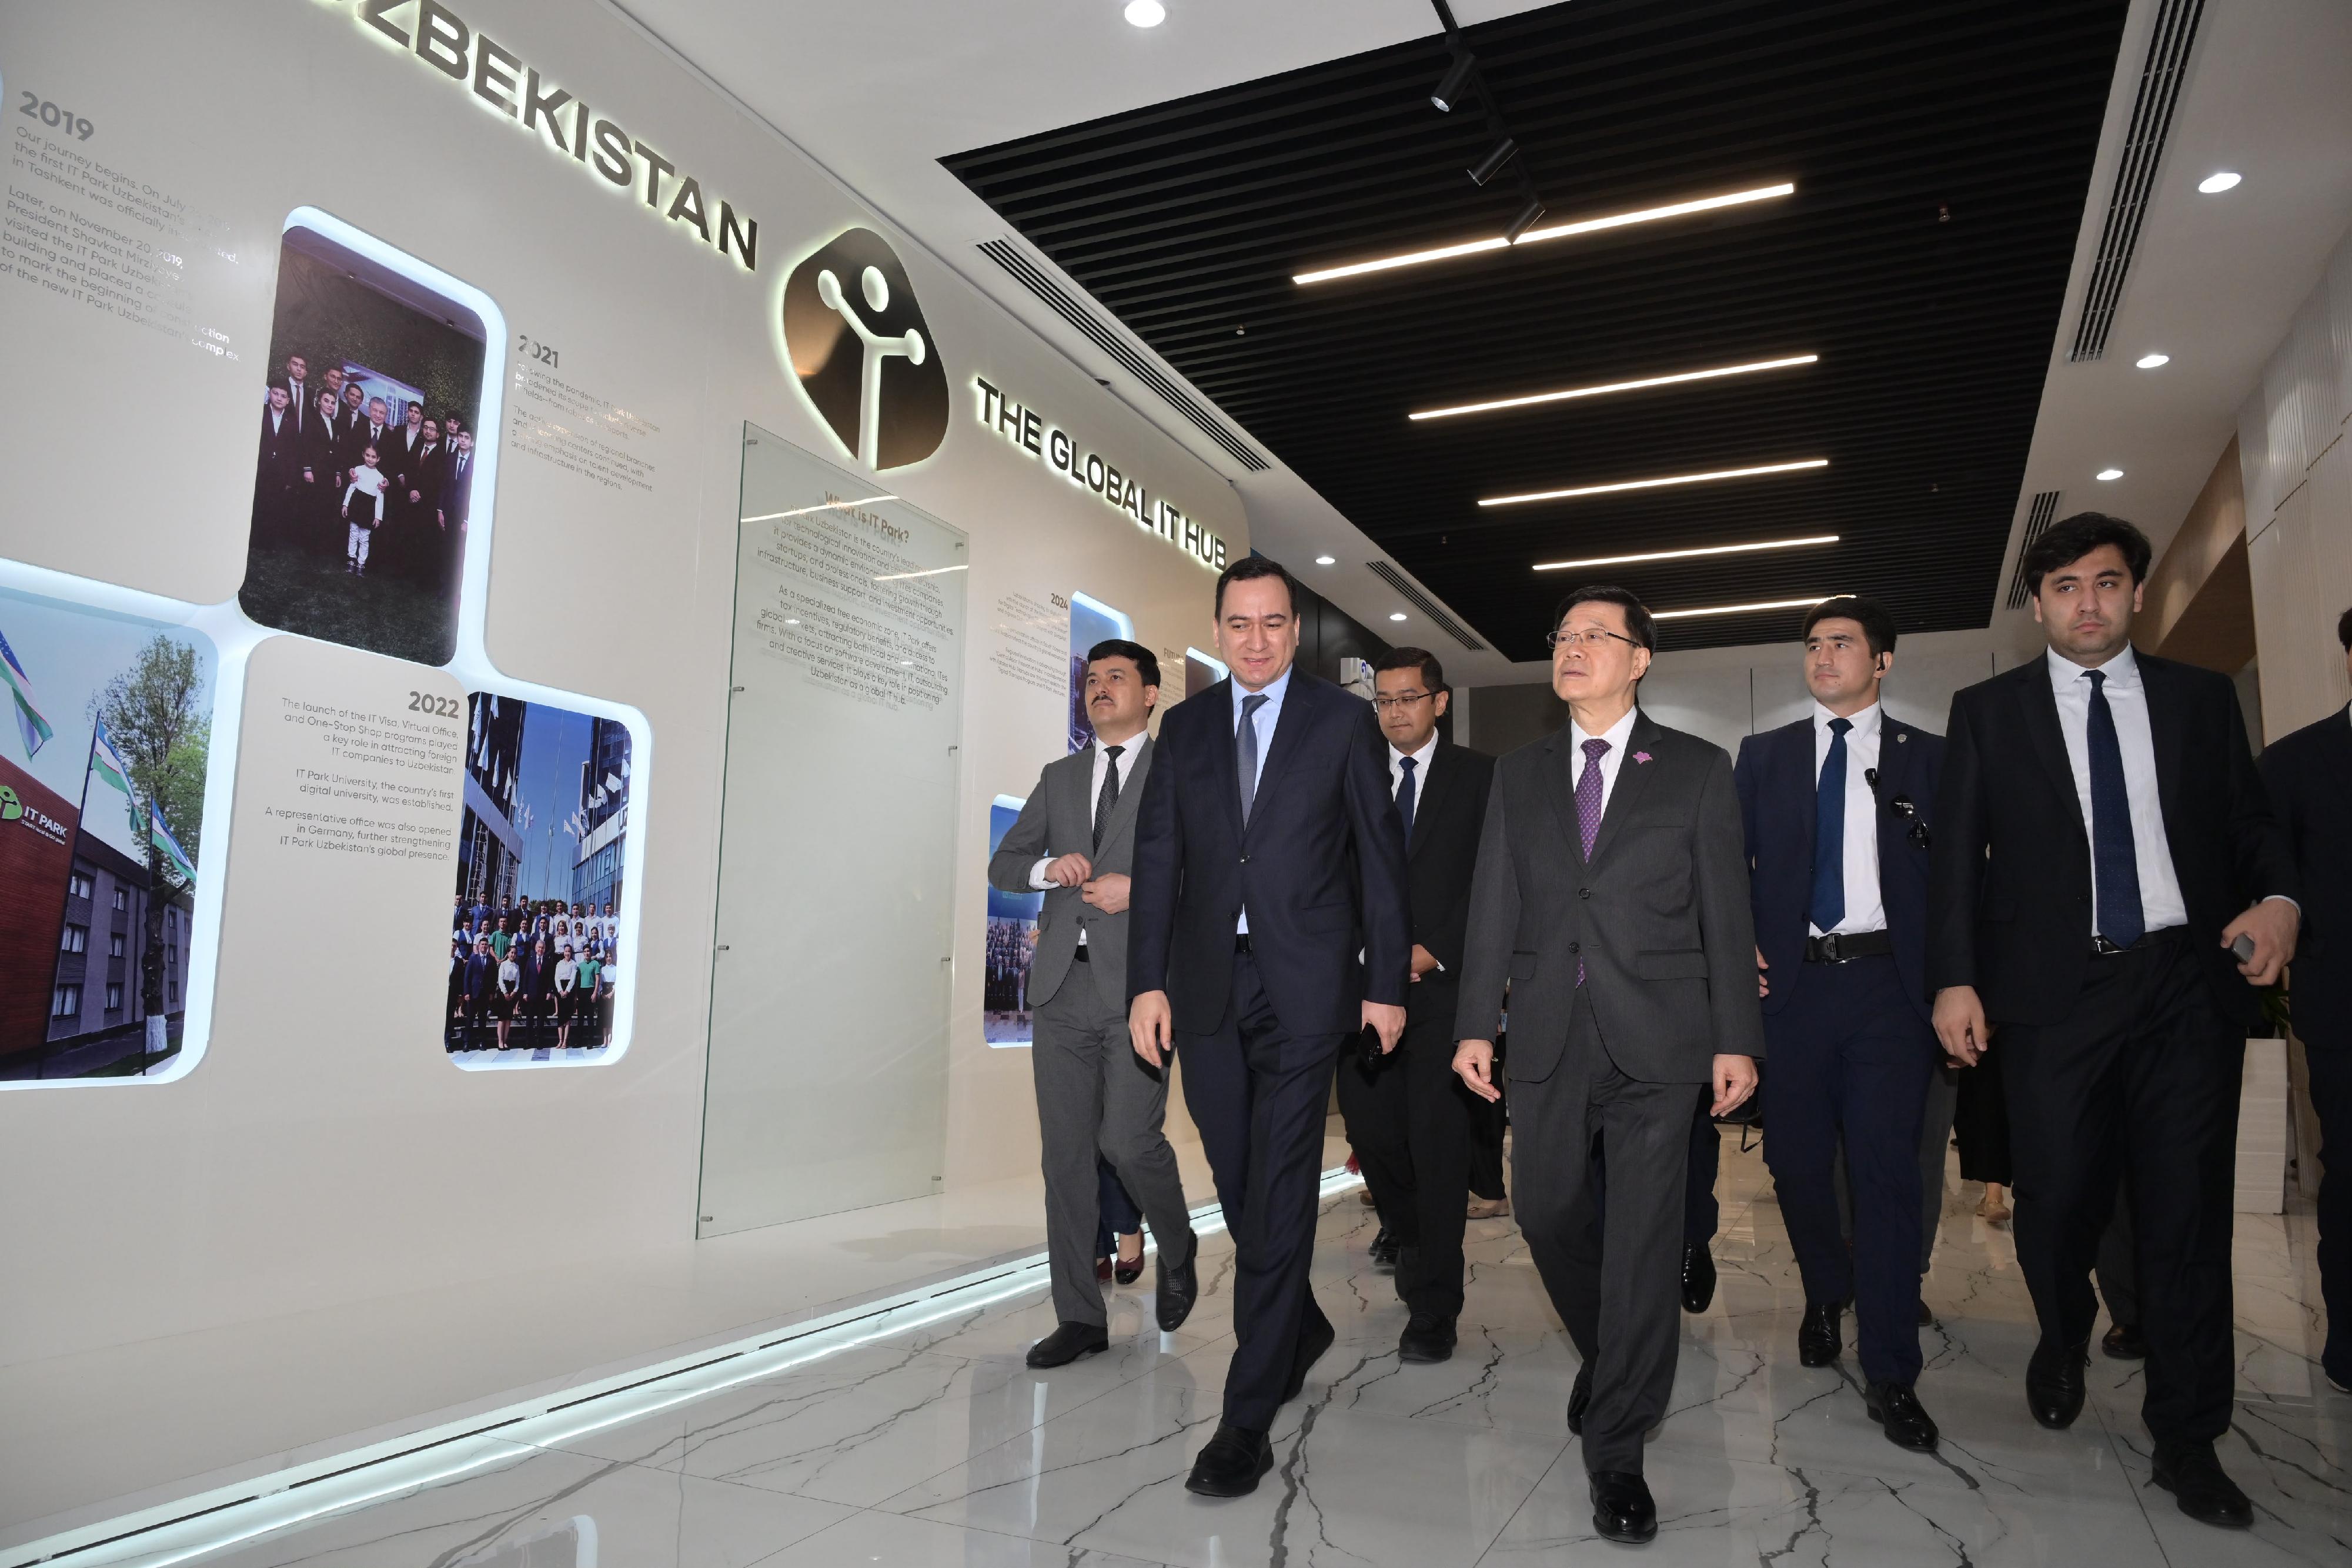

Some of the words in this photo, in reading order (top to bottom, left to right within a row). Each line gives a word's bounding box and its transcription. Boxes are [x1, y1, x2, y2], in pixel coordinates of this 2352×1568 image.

[19, 91, 94, 141] 2019
[356, 0, 758, 272] ZBEKISTAN
[14, 141, 37, 158] the
[40, 152, 64, 171] first
[67, 164, 79, 176] IT
[81, 170, 109, 191] Park
[112, 184, 185, 226] Uzbekistan's
[16, 126, 42, 145] Our
[42, 138, 92, 169] journey
[95, 162, 138, 190] begins.
[142, 184, 159, 200] On
[162, 195, 186, 212] July
[28, 161, 86, 196] Tashkent
[116, 204, 165, 232] officially
[7, 199, 69, 235] President
[72, 227, 123, 258] Shavkat
[9, 184, 45, 210] Later,
[69, 210, 133, 246] November
[136, 240, 153, 257] 20,
[2, 229, 56, 262] building
[59, 256, 86, 272] and
[88, 266, 132, 290] placed
[5, 217, 49, 241] visited
[51, 235, 74, 251] the
[76, 244, 89, 256] IT
[91, 250, 118, 270] Park
[16, 268, 39, 284] the
[42, 279, 69, 296] new
[72, 288, 84, 301] IT
[86, 294, 114, 313] Park
[19, 254, 52, 274] mark
[56, 268, 77, 283] the
[81, 276, 142, 311] beginning
[518, 335, 559, 369] 2021
[553, 378, 564, 389] the
[566, 385, 602, 407] pandemic,
[568, 398, 589, 412] scope
[513, 405, 527, 417] The
[599, 444, 625, 459] regional
[627, 454, 655, 472] branches
[513, 418, 527, 429] and
[568, 442, 593, 457] centers
[595, 453, 629, 473] continued,
[631, 467, 644, 478] with
[512, 441, 526, 451] and
[528, 447, 574, 471] infrastructure
[584, 469, 595, 479] the
[597, 475, 622, 490] regions.
[544, 443, 577, 461] emphasis
[590, 461, 609, 474] talent
[611, 470, 653, 492] development
[977, 376, 1042, 456] THE
[1050, 429, 1154, 528] GLOBAL
[1160, 500, 1180, 541] IT
[1185, 517, 1227, 572] HUB
[781, 531, 811, 550] provides
[820, 546, 848, 566] dynamic
[794, 520, 840, 549] technological
[842, 541, 876, 563] innovation
[877, 560, 889, 570] and
[815, 517, 852, 540] Uzbekistan
[860, 538, 871, 549] the
[869, 513, 879, 529] IT
[881, 518, 909, 543] Park?
[776, 542, 808, 564] startups,
[757, 547, 808, 577] infrastructure,
[810, 568, 838, 588] business
[868, 596, 881, 606] and
[883, 599, 916, 619] investment
[1051, 593, 1068, 611] 2024
[760, 608, 785, 623] global
[818, 629, 852, 649] attracting
[854, 640, 869, 654] both
[870, 646, 886, 659] local
[794, 604, 830, 627] incentives,
[832, 620, 866, 640] regulatory
[867, 632, 893, 650] benefits,
[796, 593, 836, 614] specialized
[837, 607, 850, 619] free
[852, 615, 883, 632] economic
[757, 620, 777, 634] firms.
[779, 626, 796, 641] With
[804, 636, 823, 650] focus
[835, 648, 863, 664] software
[769, 640, 784, 651] and
[786, 646, 815, 661] creative
[853, 668, 870, 680] plays
[877, 675, 888, 687] key
[889, 680, 900, 690] role
[811, 666, 848, 686] Uzbekistan
[865, 686, 885, 698] global
[894, 693, 906, 705] hub.
[282, 697, 300, 710] The
[303, 701, 336, 716] launch
[350, 711, 366, 721] the
[368, 713, 377, 723] IT
[379, 715, 399, 729] Visa,
[402, 720, 430, 733] Virtual
[432, 726, 459, 740] Office,
[408, 691, 460, 720] 2022
[284, 714, 305, 724] and
[307, 716, 356, 734] One-Stop
[358, 725, 382, 739] Shop
[384, 731, 427, 745] programs
[428, 738, 458, 751] played
[332, 733, 349, 747] key
[351, 738, 369, 748] role
[380, 744, 426, 760] attracting
[427, 749, 457, 764] foreign
[332, 746, 341, 756] IT
[342, 751, 393, 765] companies
[296, 768, 306, 778] IT
[307, 770, 329, 783] Park
[332, 773, 378, 791] University,
[380, 781, 396, 791] the
[397, 785, 437, 798] country's
[439, 789, 455, 799] first
[299, 783, 332, 795] digital
[333, 788, 379, 804] university,
[402, 798, 453, 812] established.
[21, 819, 35, 830] START
[24, 805, 39, 821] IT
[38, 814, 68, 838] PARK
[275, 809, 348, 824] representative
[349, 817, 375, 828] office
[397, 822, 416, 833] also
[418, 826, 452, 837] opened
[308, 825, 355, 840] Germany,
[357, 830, 389, 842] further
[390, 835, 451, 851] strengthening
[280, 835, 290, 845] IT
[292, 837, 315, 848] Park
[316, 839, 375, 854] Uzbekistan's
[377, 846, 407, 857] global
[408, 851, 449, 861] presence.
